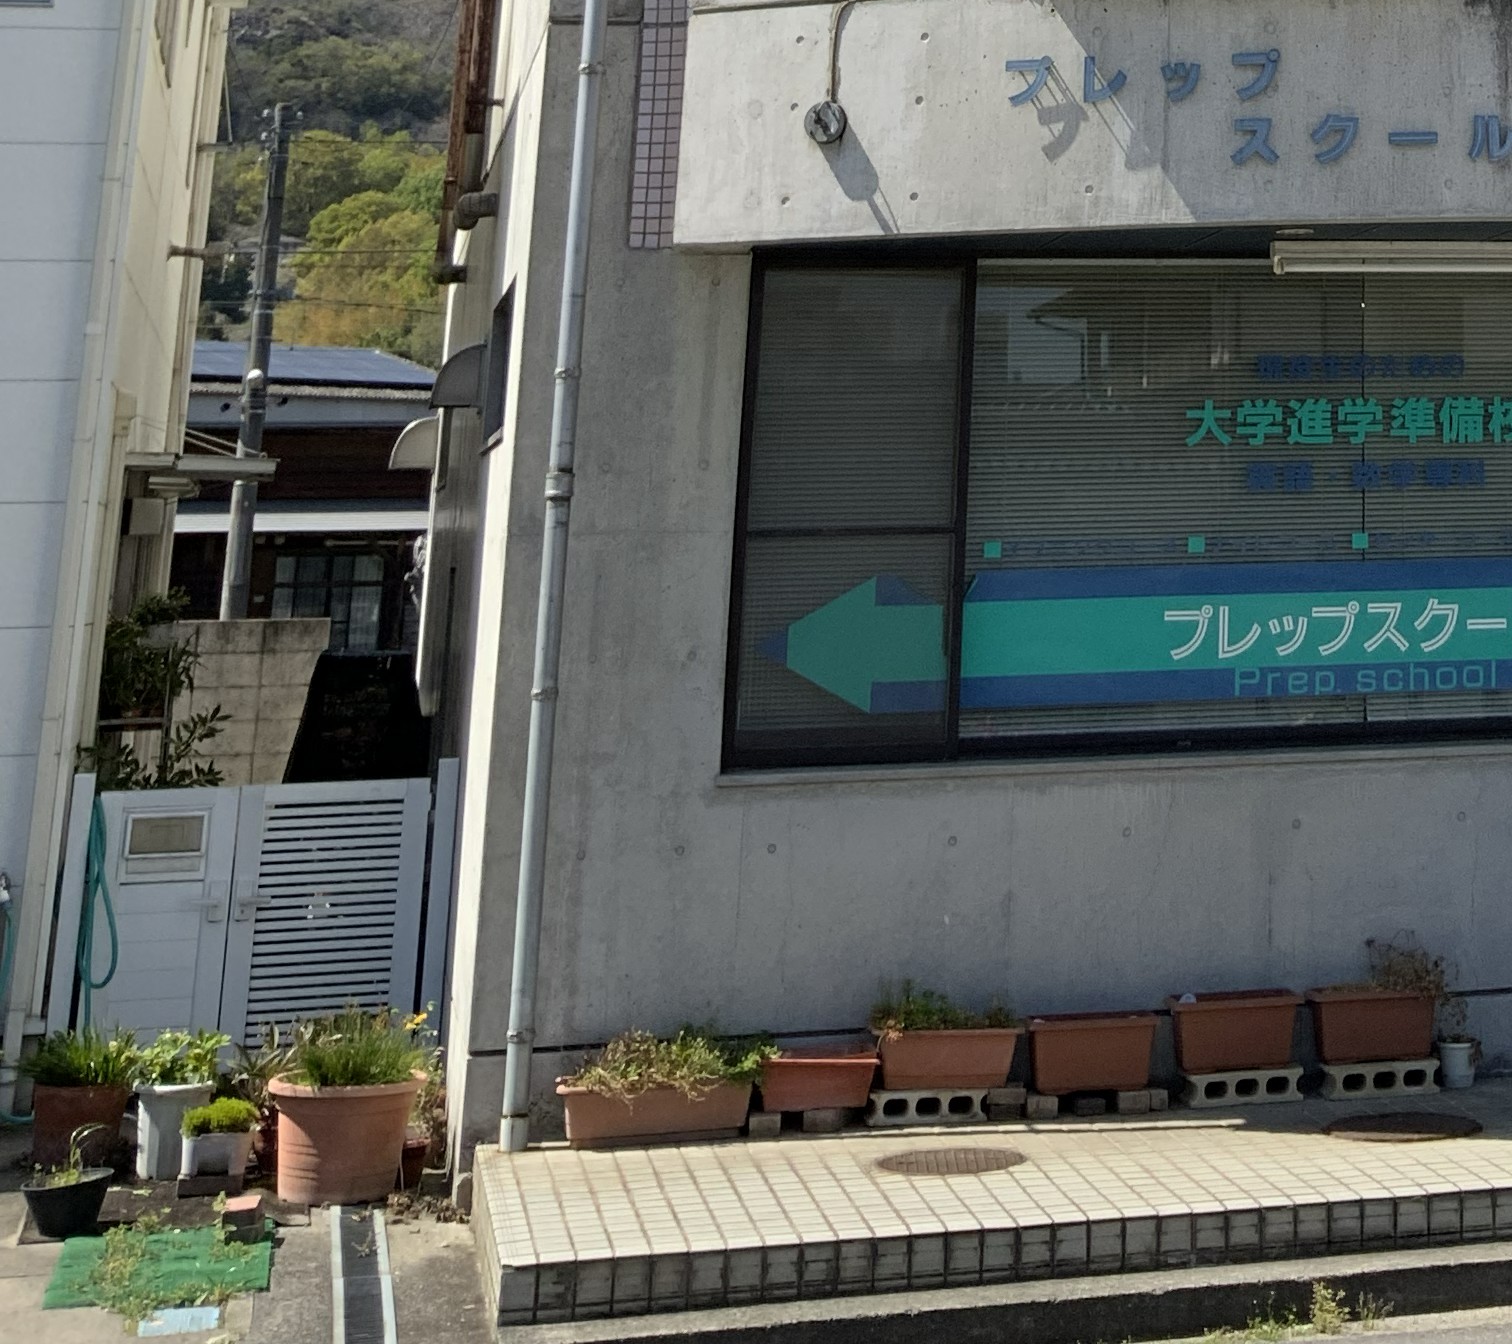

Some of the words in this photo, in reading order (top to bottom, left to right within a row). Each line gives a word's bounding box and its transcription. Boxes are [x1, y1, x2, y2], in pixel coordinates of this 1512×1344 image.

[1005, 47, 1281, 107] プレップ
[1355, 659, 1499, 693] school
